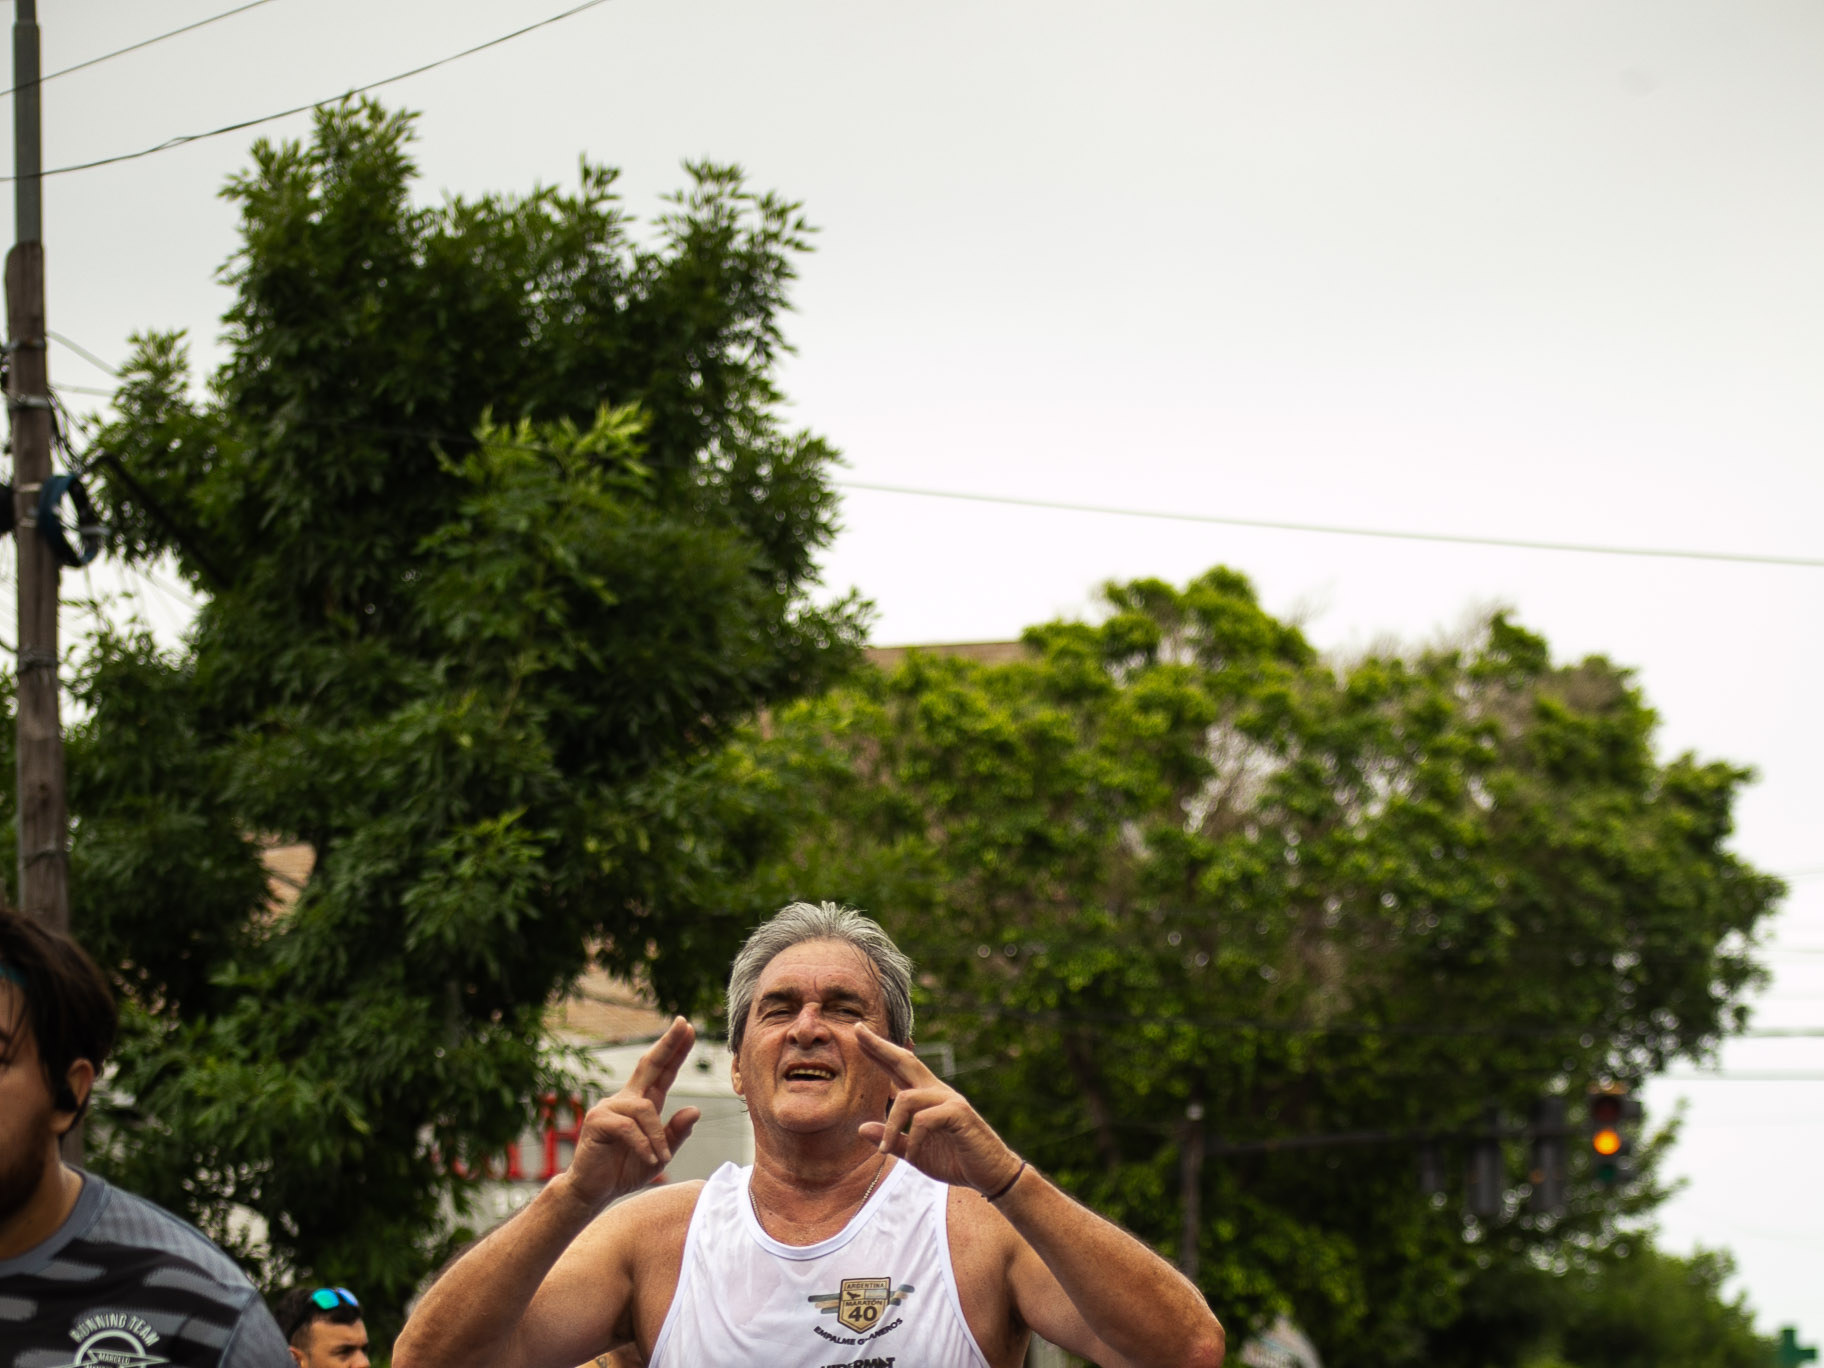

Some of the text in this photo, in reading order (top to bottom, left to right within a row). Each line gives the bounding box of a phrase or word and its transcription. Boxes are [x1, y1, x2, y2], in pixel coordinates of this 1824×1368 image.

[847, 1282, 885, 1290] ARGENTINA
[845, 1299, 883, 1307] MARATÓN
[848, 1306, 878, 1322] 40
[69, 1312, 160, 1347] RUNNING TEAM
[813, 1325, 856, 1346] EMPALME
